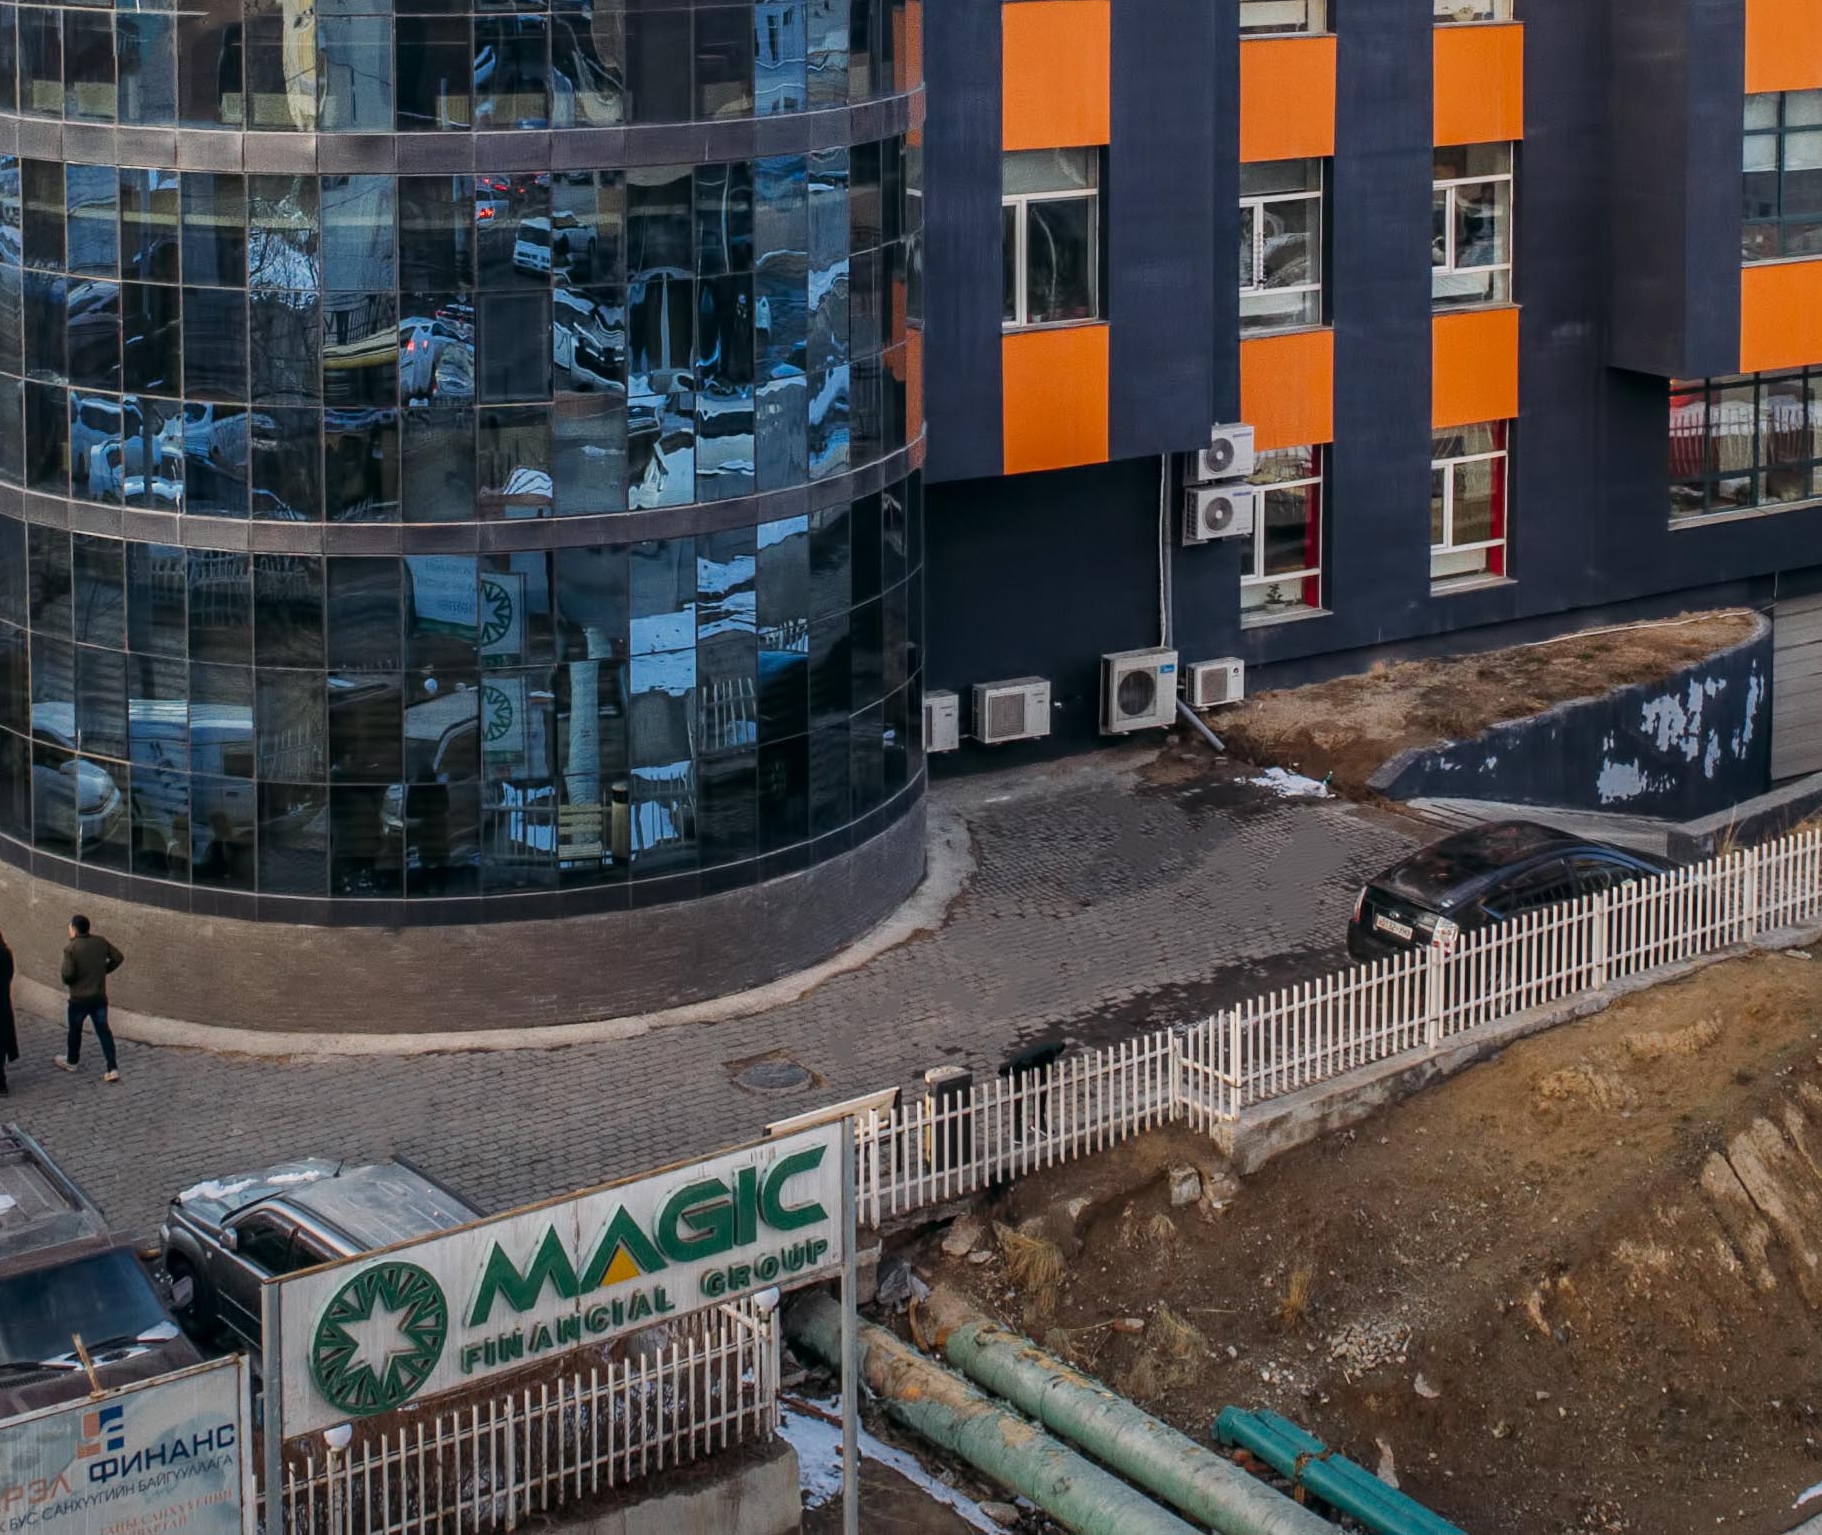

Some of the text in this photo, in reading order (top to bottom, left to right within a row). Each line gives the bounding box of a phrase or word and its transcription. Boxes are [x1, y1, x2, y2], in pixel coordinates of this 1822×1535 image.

[464, 1144, 829, 1328] MAGIC
[460, 1238, 829, 1374] FINANCIAL GROUP
[88, 1422, 236, 1484] ФИНАНС
